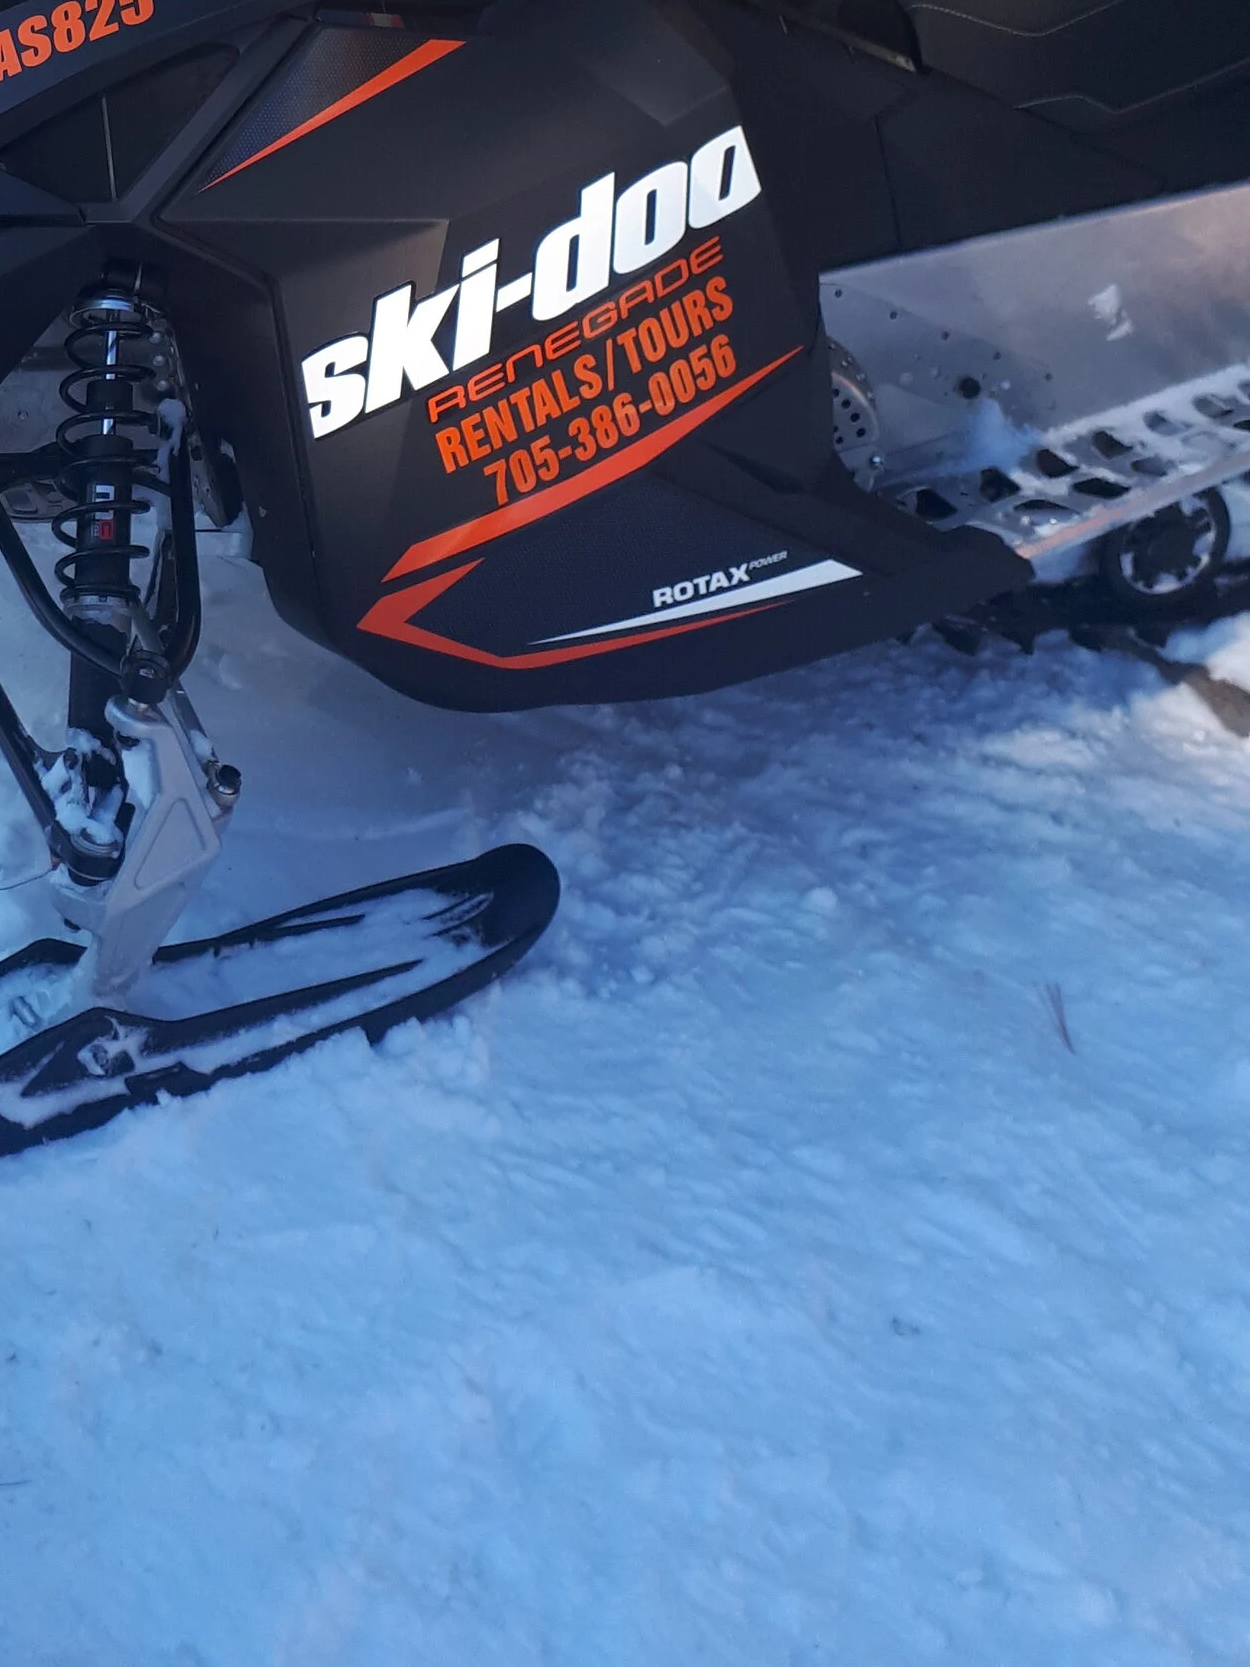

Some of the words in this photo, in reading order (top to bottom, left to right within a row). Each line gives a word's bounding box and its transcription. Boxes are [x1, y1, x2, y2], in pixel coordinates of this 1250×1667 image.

[301, 125, 762, 439] ski-doo
[427, 235, 725, 424] RENEGADE
[435, 276, 734, 474] RENTALS/TOURS
[483, 333, 737, 506] 705-386-0056
[652, 563, 750, 608] ROTAX
[749, 550, 788, 571] POWER
